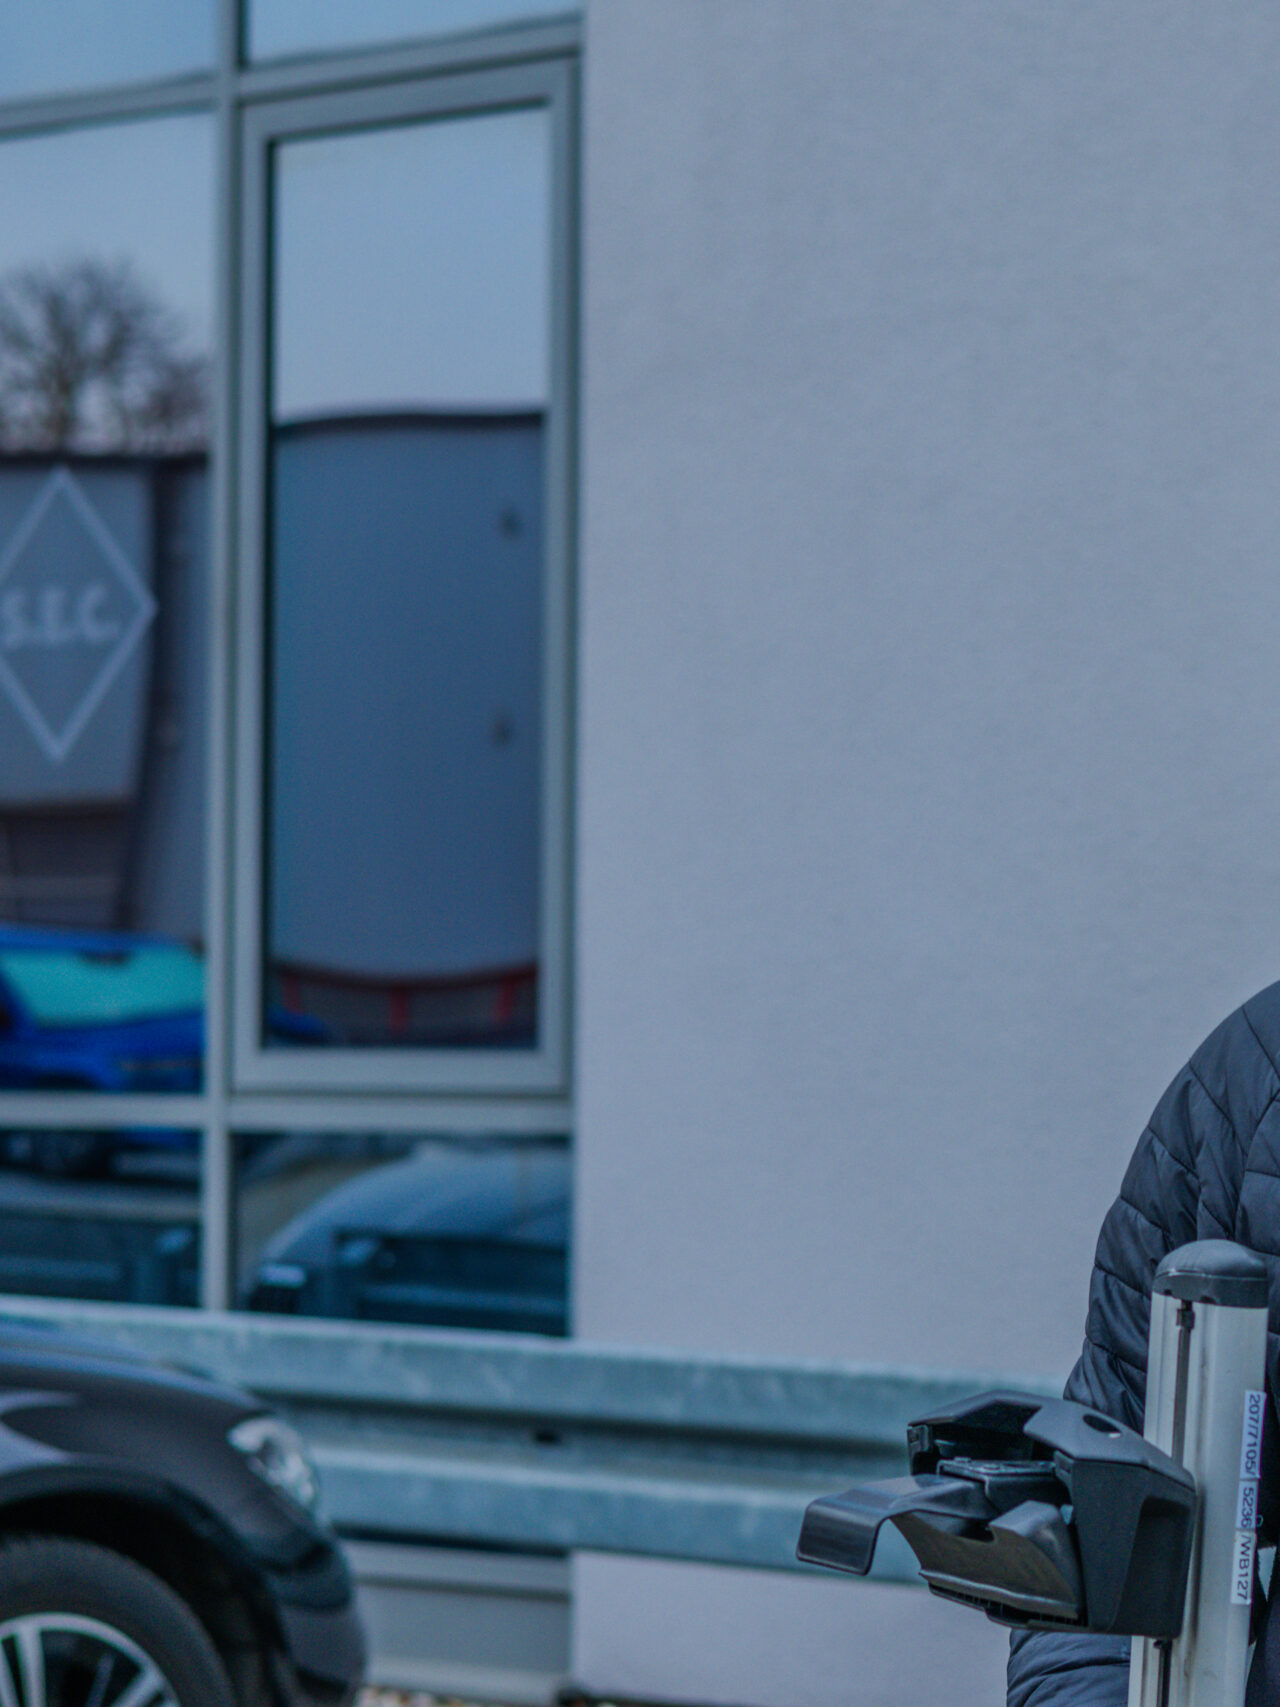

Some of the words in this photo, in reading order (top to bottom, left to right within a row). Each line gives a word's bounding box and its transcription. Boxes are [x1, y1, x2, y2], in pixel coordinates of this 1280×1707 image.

[1245, 1392, 1262, 1476] 207/7105/
[1240, 1487, 1254, 1528] 5236
[1236, 1534, 1253, 1600] /WB127
